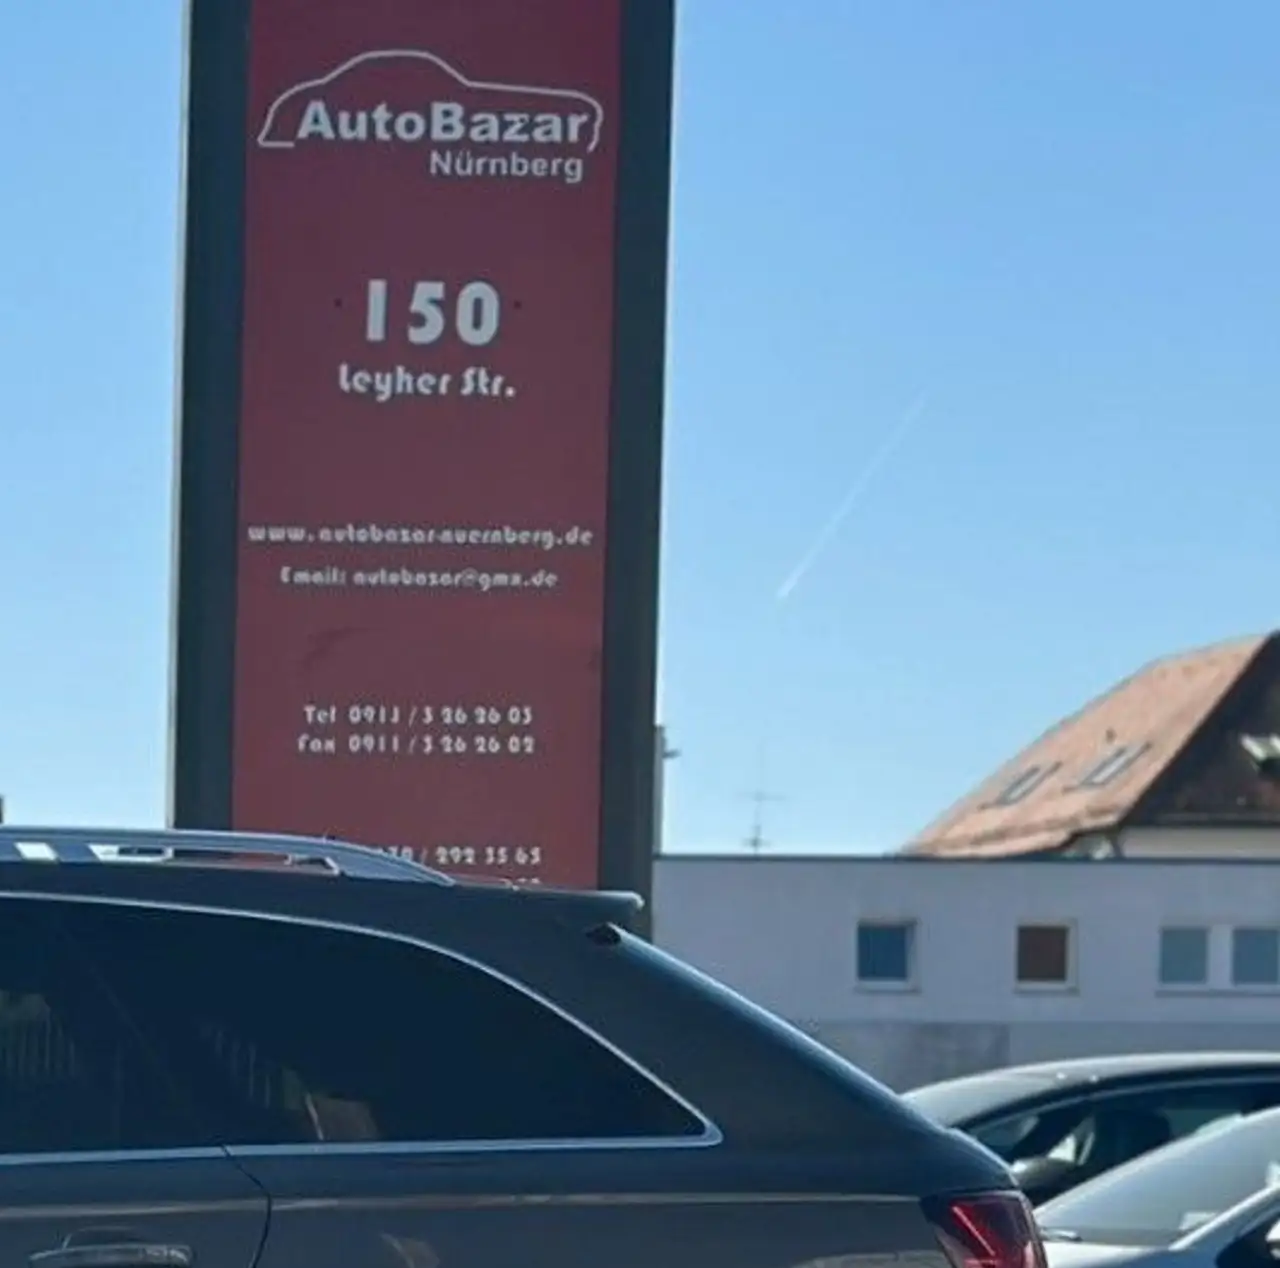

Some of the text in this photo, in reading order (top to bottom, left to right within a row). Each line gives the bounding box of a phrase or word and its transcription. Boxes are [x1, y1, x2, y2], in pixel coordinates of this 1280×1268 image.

[297, 101, 589, 142] AutoBazar
[430, 151, 583, 183] Nürnberg
[367, 280, 499, 345] 150
[461, 367, 514, 396] Str.
[304, 706, 336, 723] Tel
[349, 706, 399, 723] 0911
[349, 734, 398, 752] 0911
